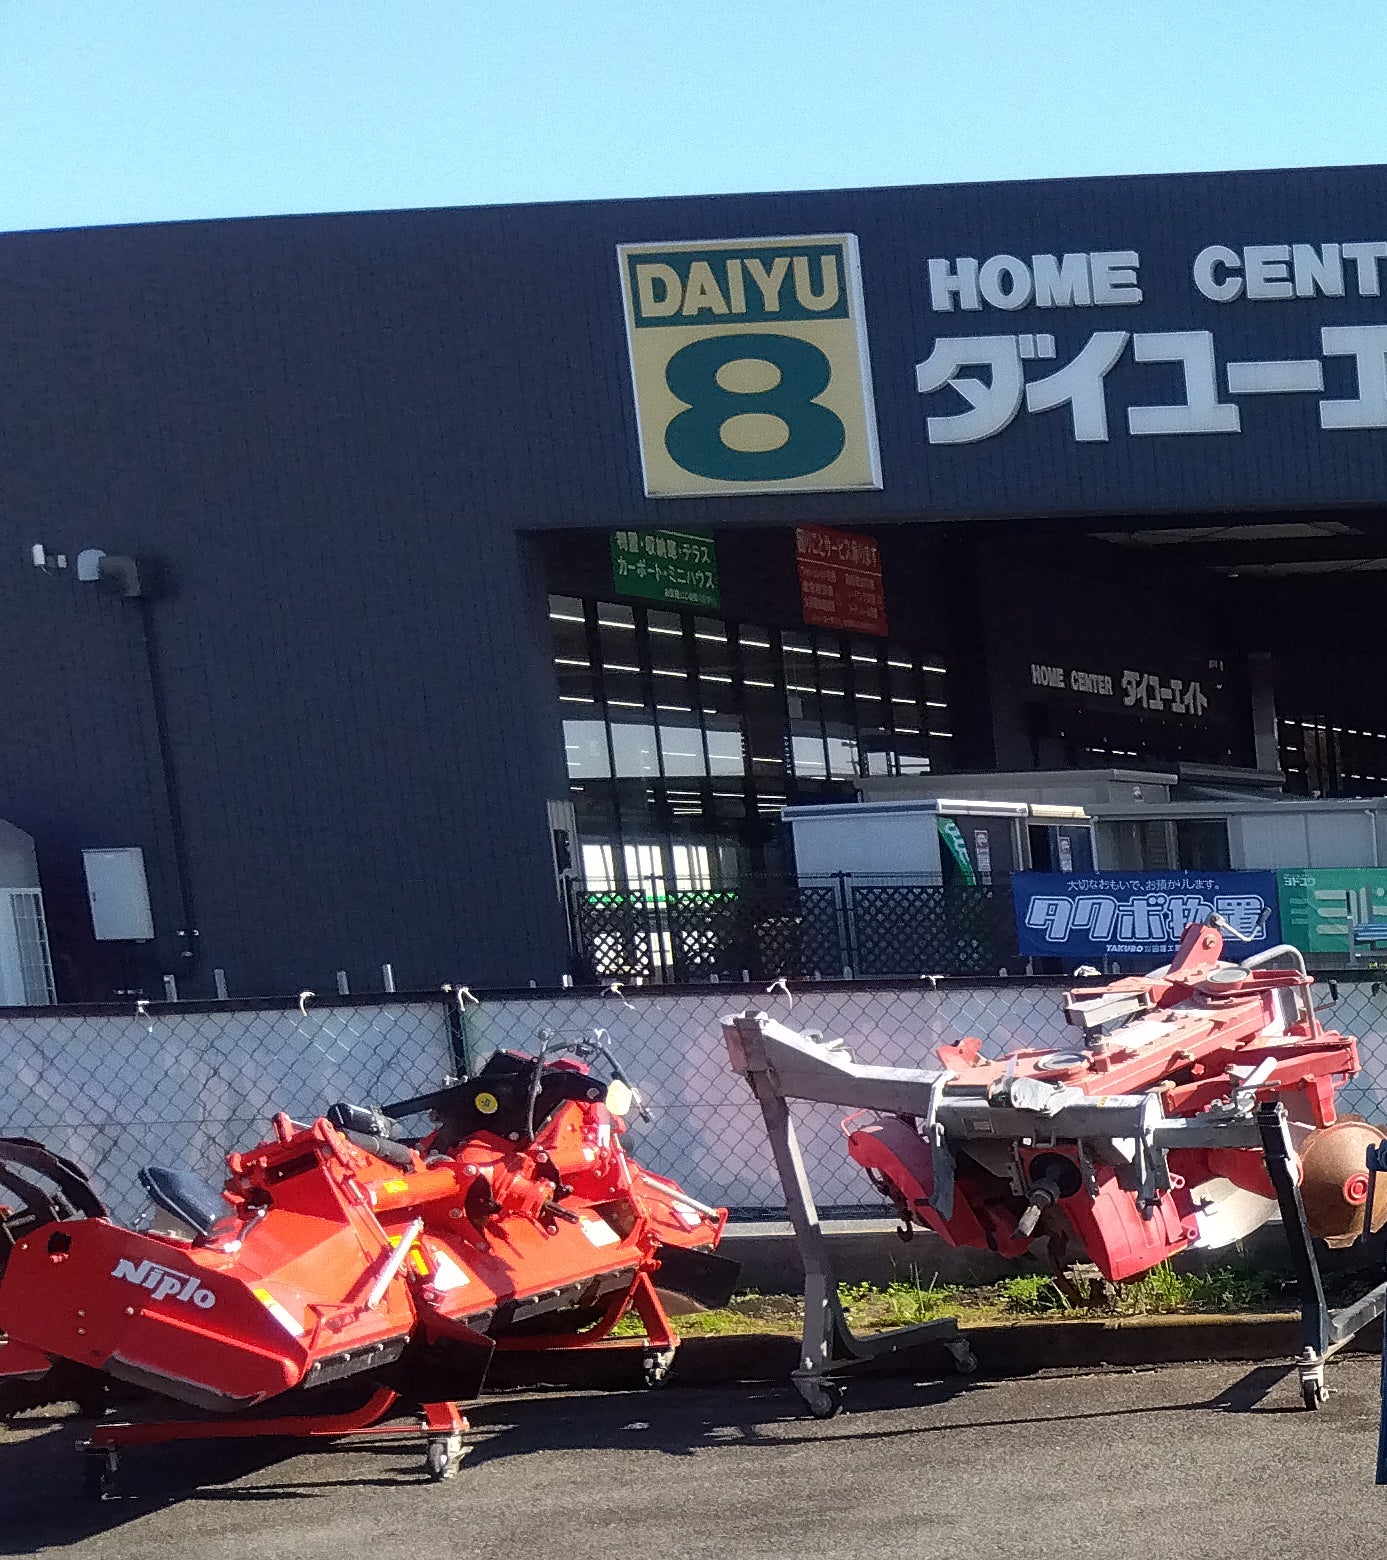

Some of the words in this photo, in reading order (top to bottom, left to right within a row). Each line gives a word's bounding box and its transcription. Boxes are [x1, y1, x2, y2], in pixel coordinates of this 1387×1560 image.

[635, 254, 840, 318] DAIYU
[928, 250, 1143, 312] HOME
[664, 332, 847, 483] 8
[1030, 663, 1066, 689] HOME
[1070, 670, 1114, 696] CENTER
[1120, 669, 1208, 716] ダイユーエイト
[1106, 944, 1144, 953] TAKUBO
[110, 1258, 216, 1309] Niplo
